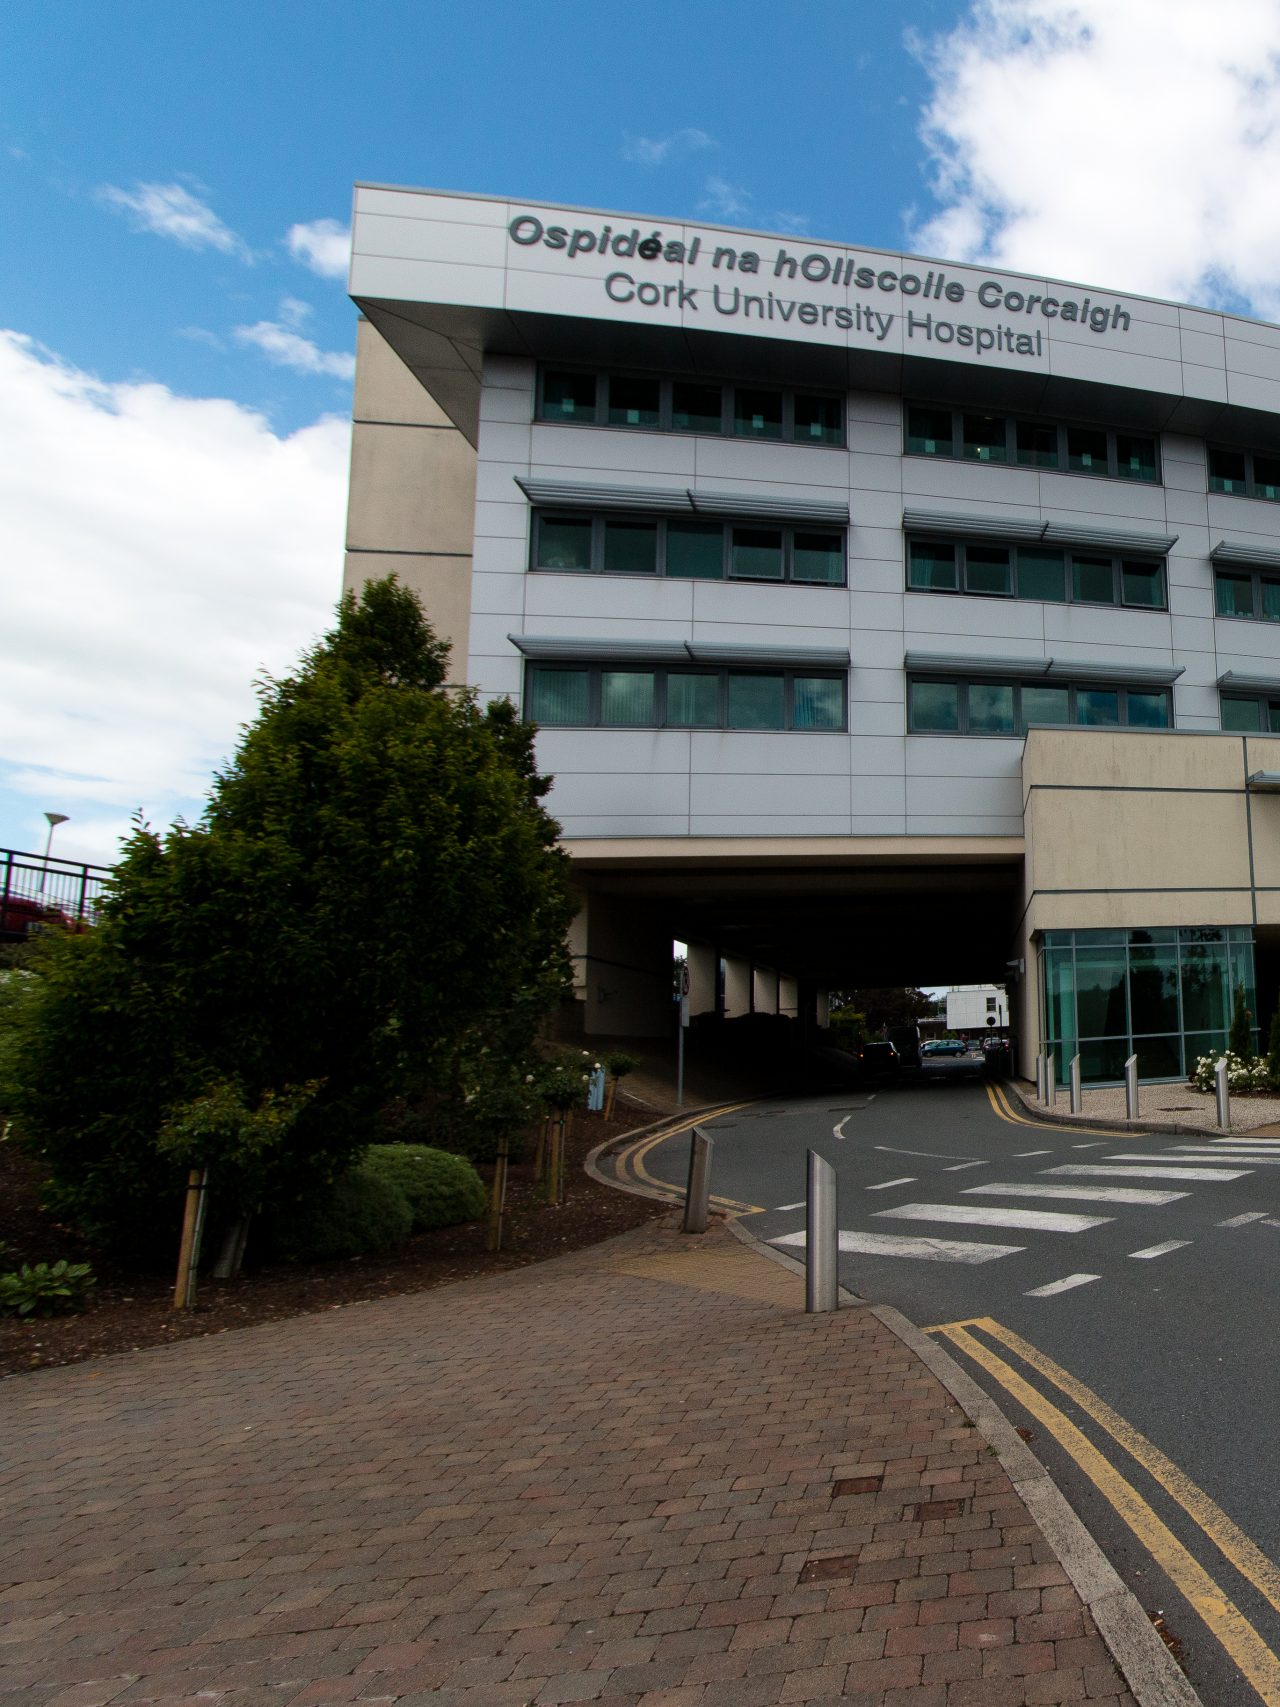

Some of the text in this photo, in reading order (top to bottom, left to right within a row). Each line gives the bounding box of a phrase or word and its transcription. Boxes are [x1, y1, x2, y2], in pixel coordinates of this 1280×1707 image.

[508, 215, 1132, 333] Ospidéal na hOllscoile Corcaigh
[605, 271, 1043, 356] Cork University Hospital
